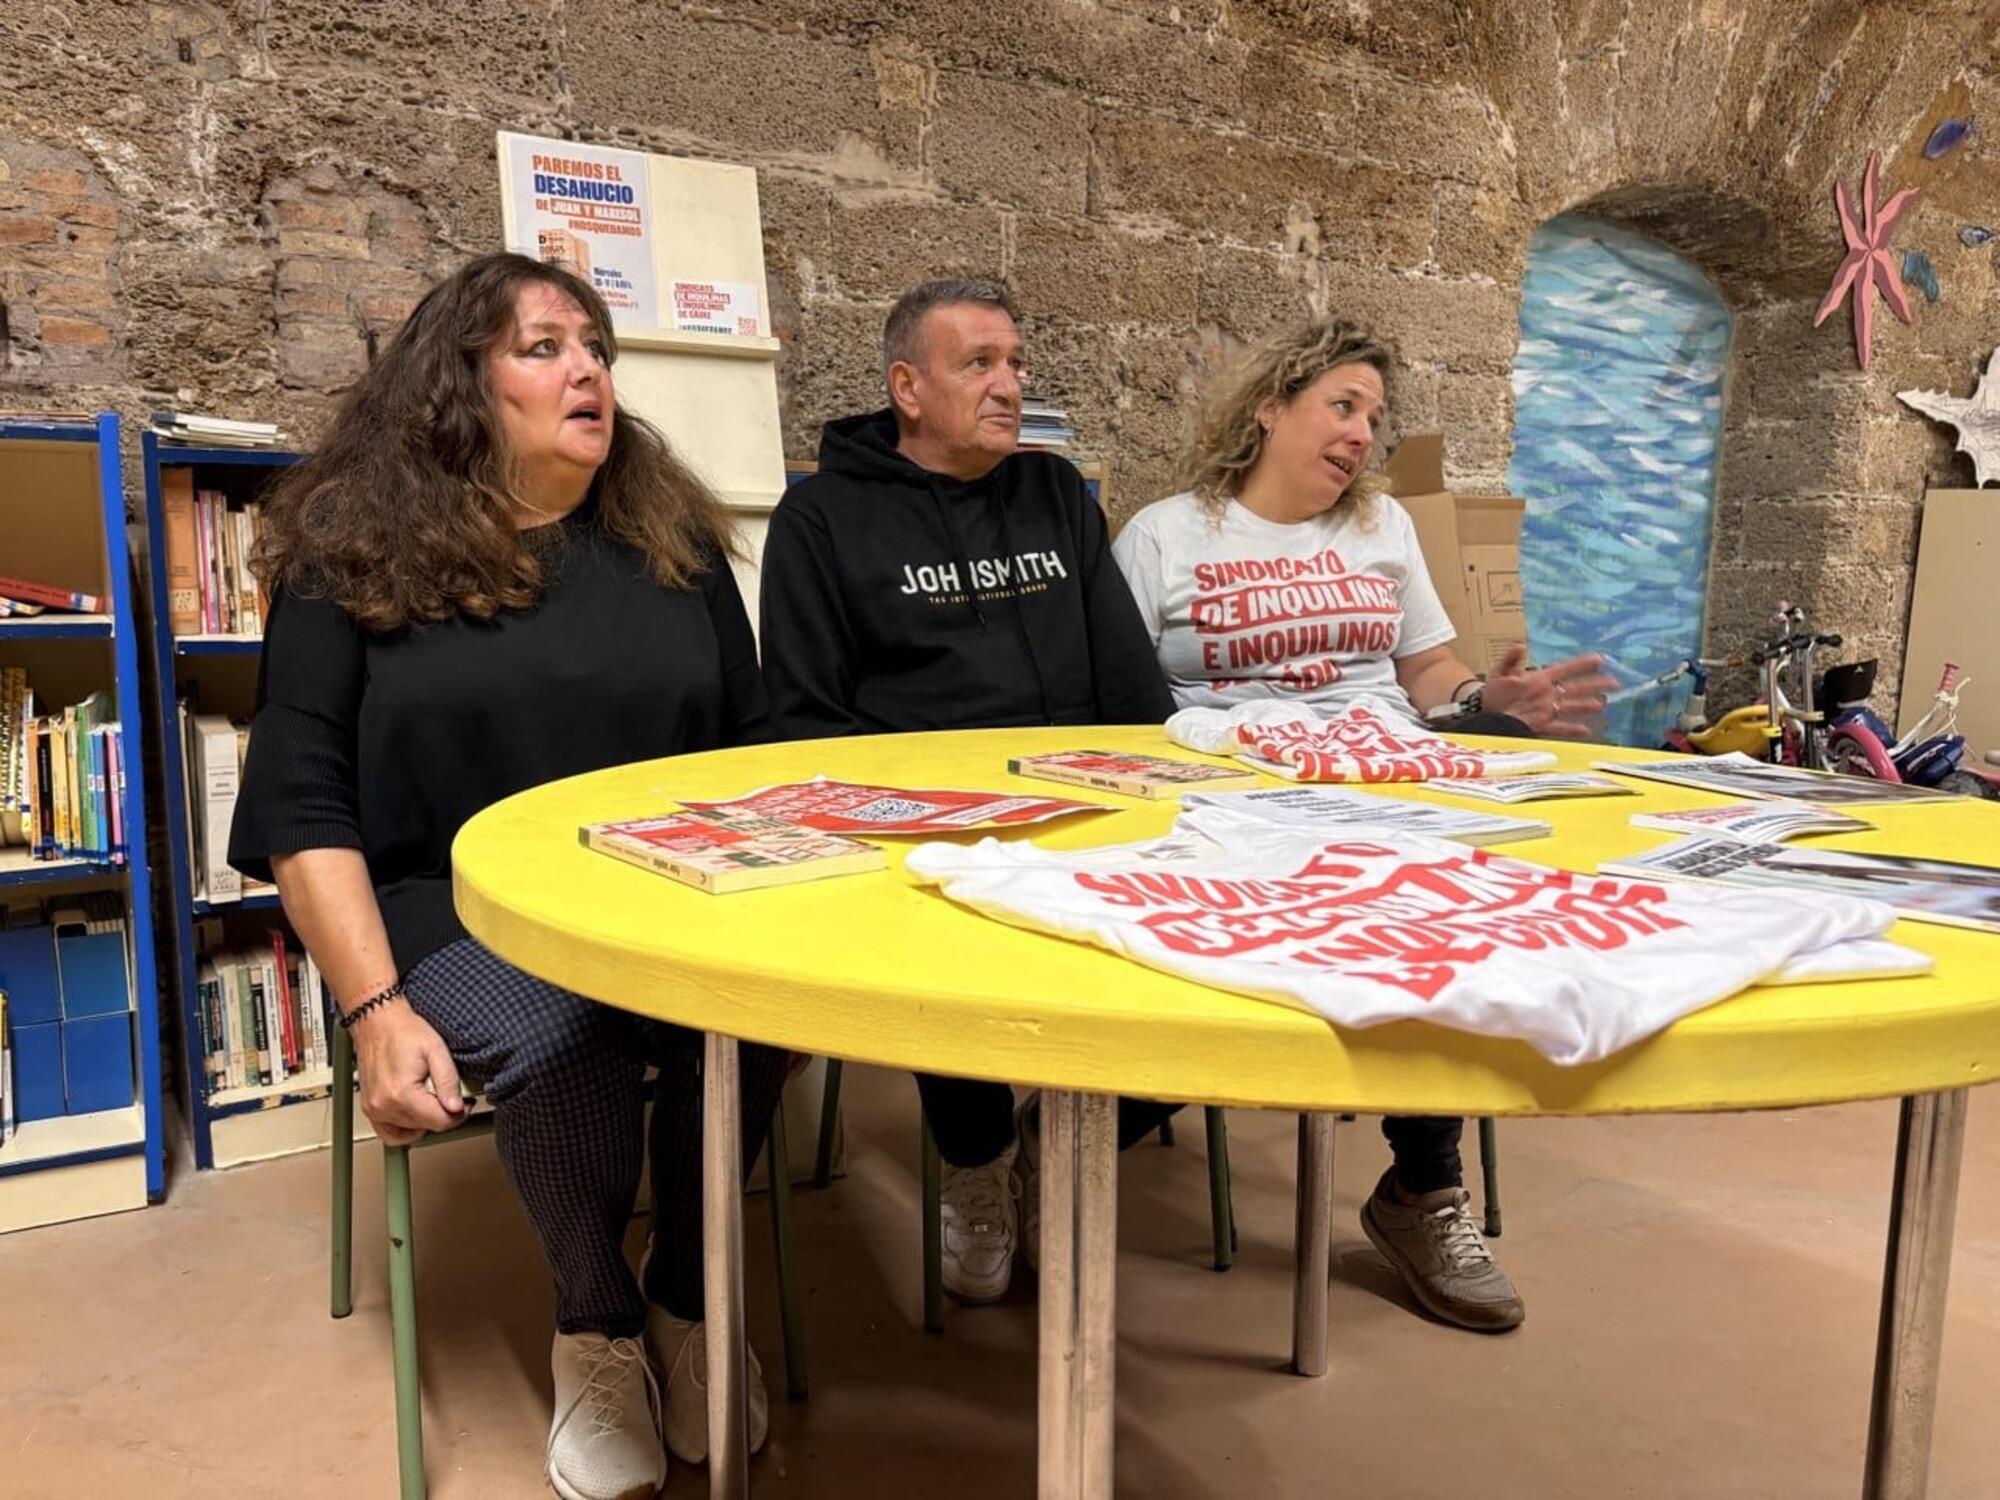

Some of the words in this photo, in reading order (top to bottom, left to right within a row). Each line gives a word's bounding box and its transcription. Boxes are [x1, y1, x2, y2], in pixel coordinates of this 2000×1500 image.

[532, 154, 604, 180] PAREMOS
[606, 165, 622, 181] EL
[534, 173, 634, 204] DESAHUCIO
[535, 198, 549, 211] DE
[1194, 549, 1346, 592] SINDICATO
[1200, 598, 1242, 628] DE
[1203, 641, 1222, 671] E
[1228, 620, 1396, 669] INQUILINOS
